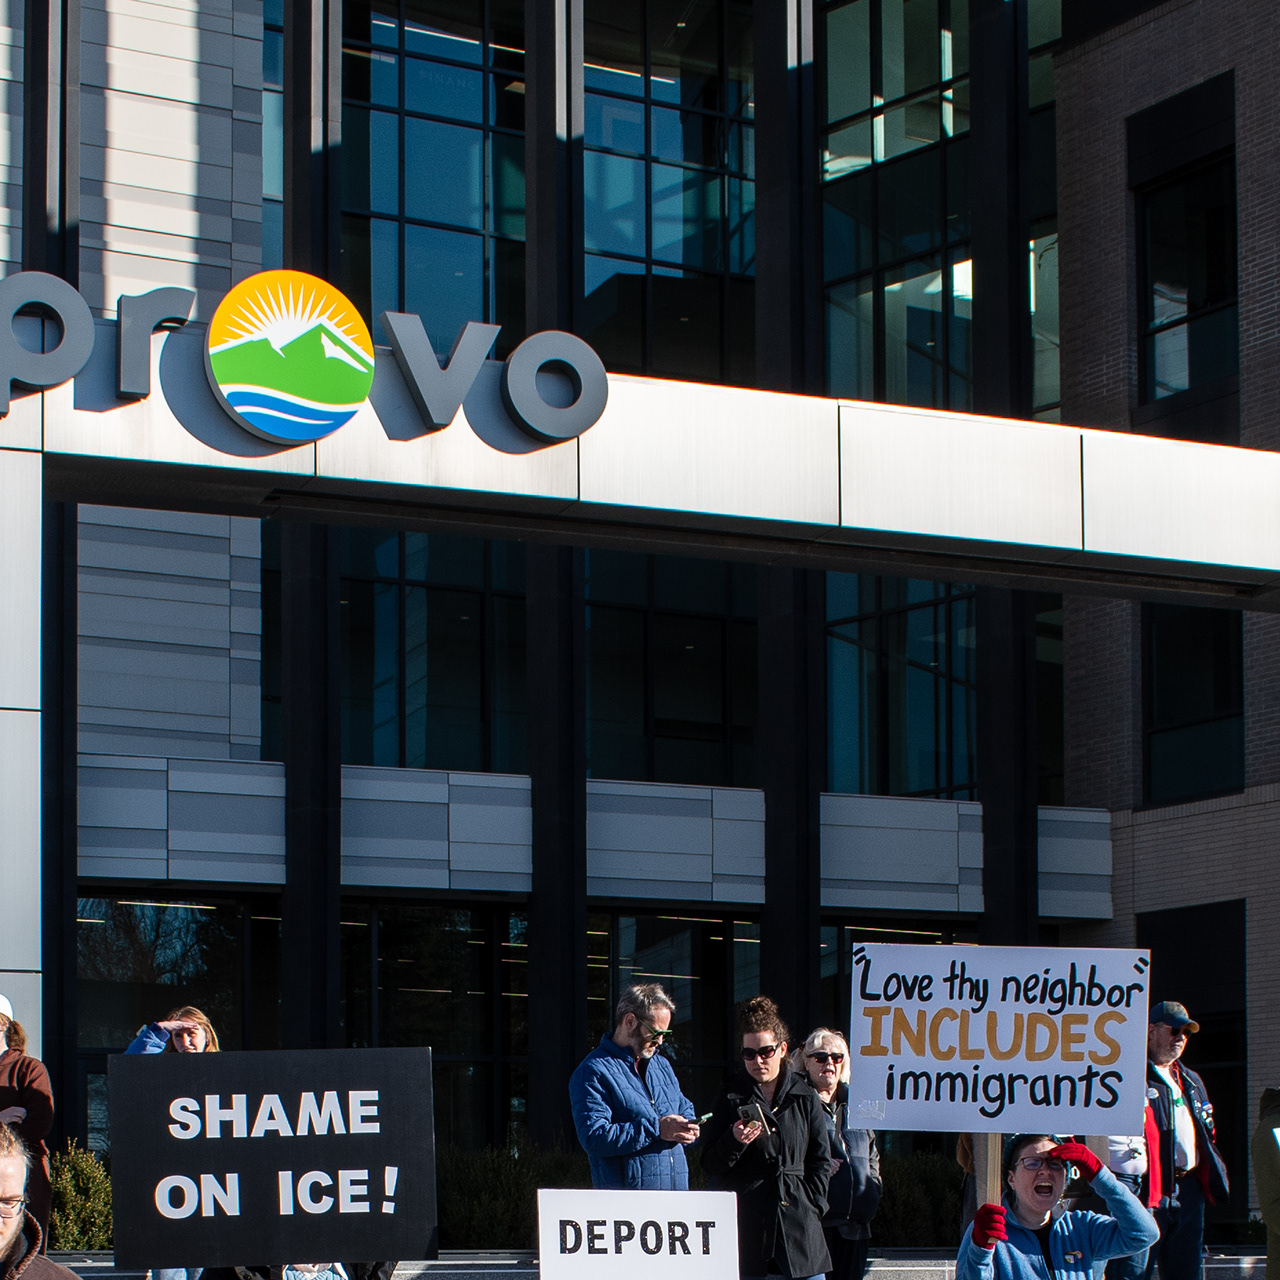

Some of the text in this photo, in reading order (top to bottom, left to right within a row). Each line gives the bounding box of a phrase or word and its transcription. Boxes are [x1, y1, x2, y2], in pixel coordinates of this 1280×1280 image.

[852, 946, 1150, 1016] "Love thy neighbor"
[859, 1005, 1128, 1066] INCLUDES
[167, 1089, 381, 1140] SHAME
[885, 1064, 1124, 1119] immigrants
[154, 1165, 399, 1220] ON ICE!
[559, 1219, 717, 1256] DEPORT
